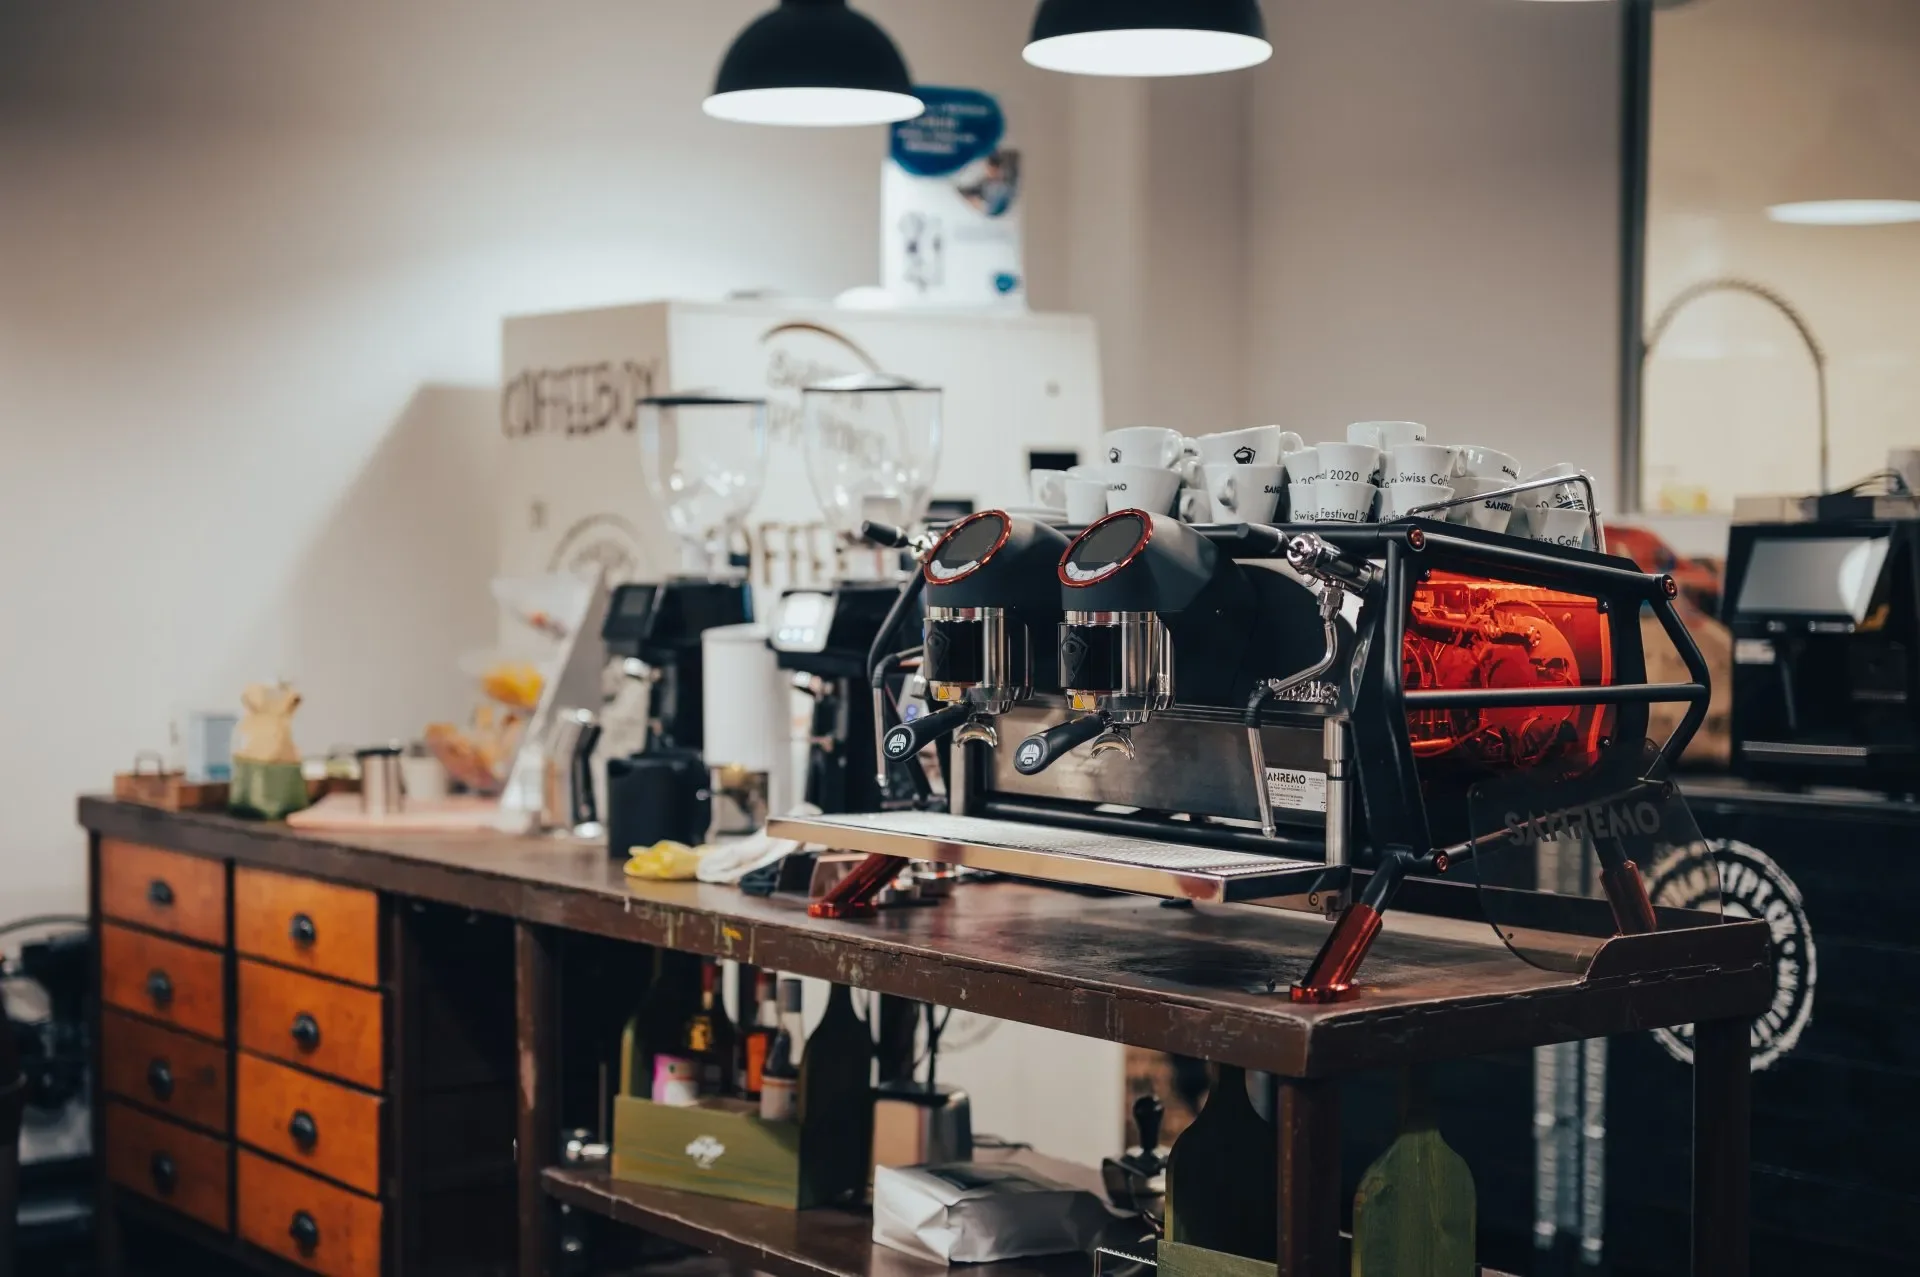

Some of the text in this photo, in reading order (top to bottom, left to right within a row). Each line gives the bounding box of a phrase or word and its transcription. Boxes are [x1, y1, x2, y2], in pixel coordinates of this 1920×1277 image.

[1330, 469, 1359, 482] 2020
[1399, 472, 1426, 483] Swiss
[1320, 507, 1358, 520] Festival
[1267, 772, 1306, 785] ANREMO
[1504, 801, 1661, 847] SANREMO
